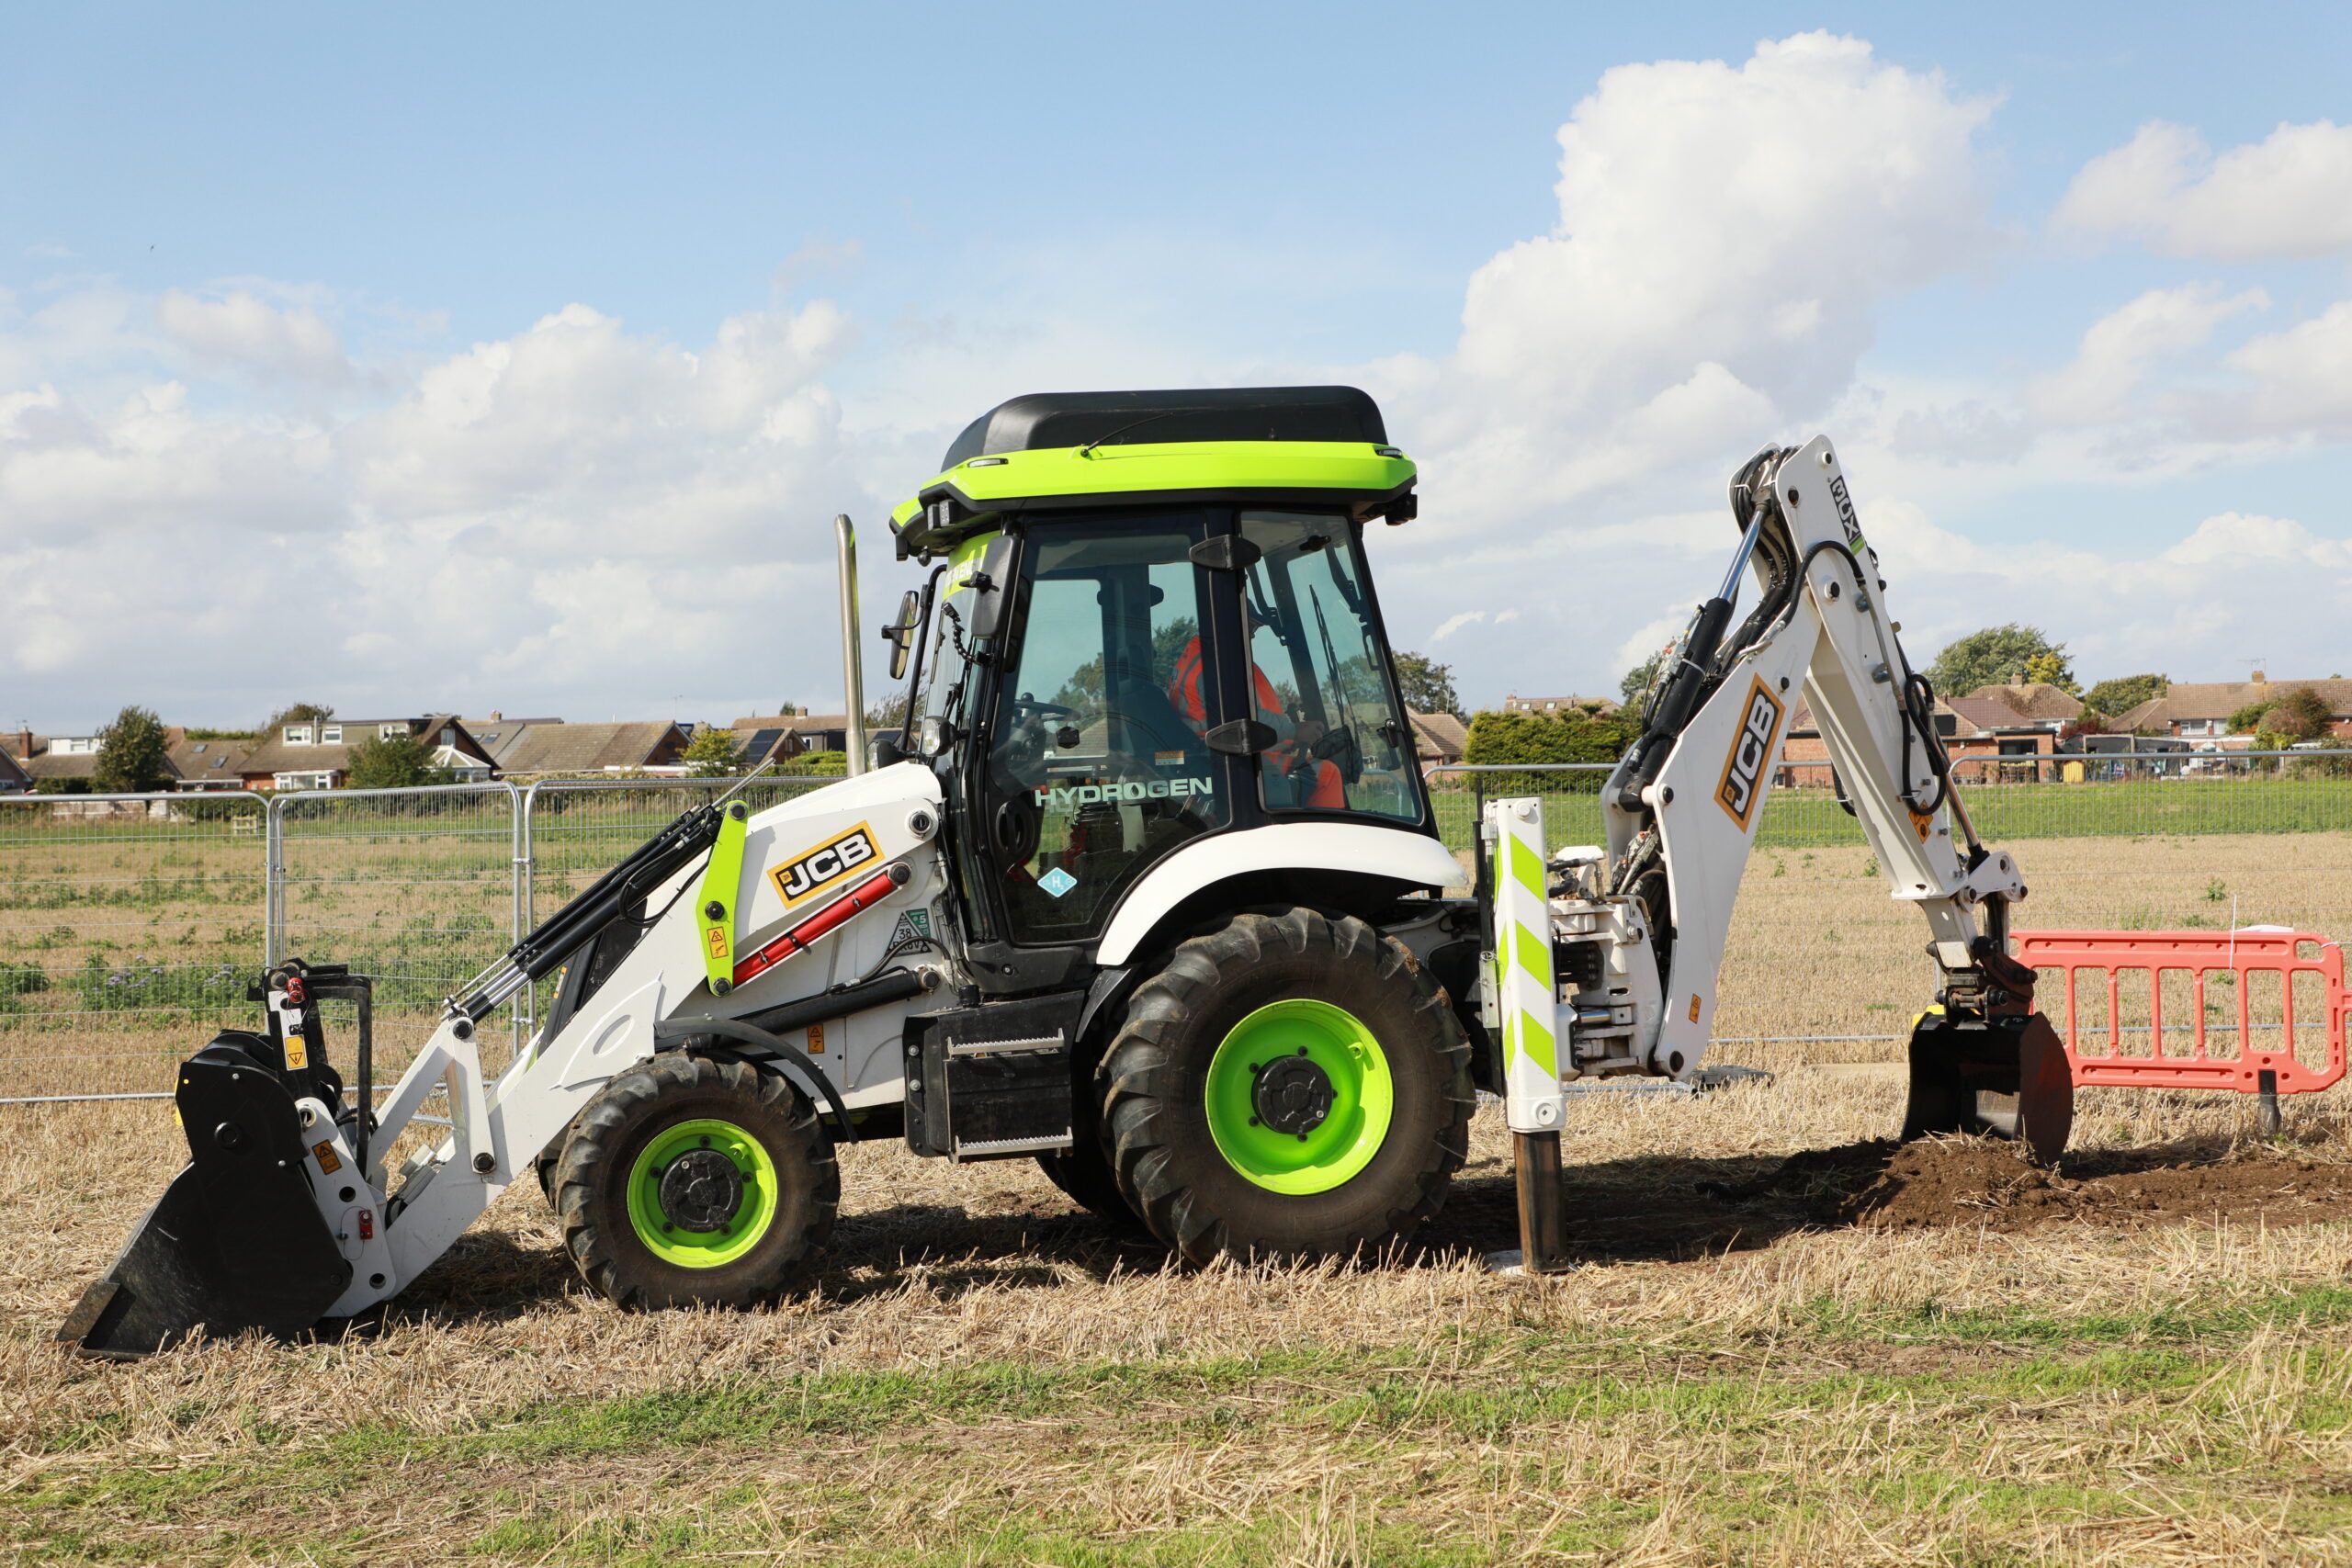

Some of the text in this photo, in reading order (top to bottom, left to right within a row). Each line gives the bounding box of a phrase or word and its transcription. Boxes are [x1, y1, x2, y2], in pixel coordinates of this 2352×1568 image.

[1831, 479, 1860, 540] 3CX
[1731, 694, 1775, 813] JCB
[1035, 777, 1213, 807] HYDROGEN
[785, 833, 872, 896] JCB
[899, 928, 911, 940] 38
[919, 915, 927, 924] 5
